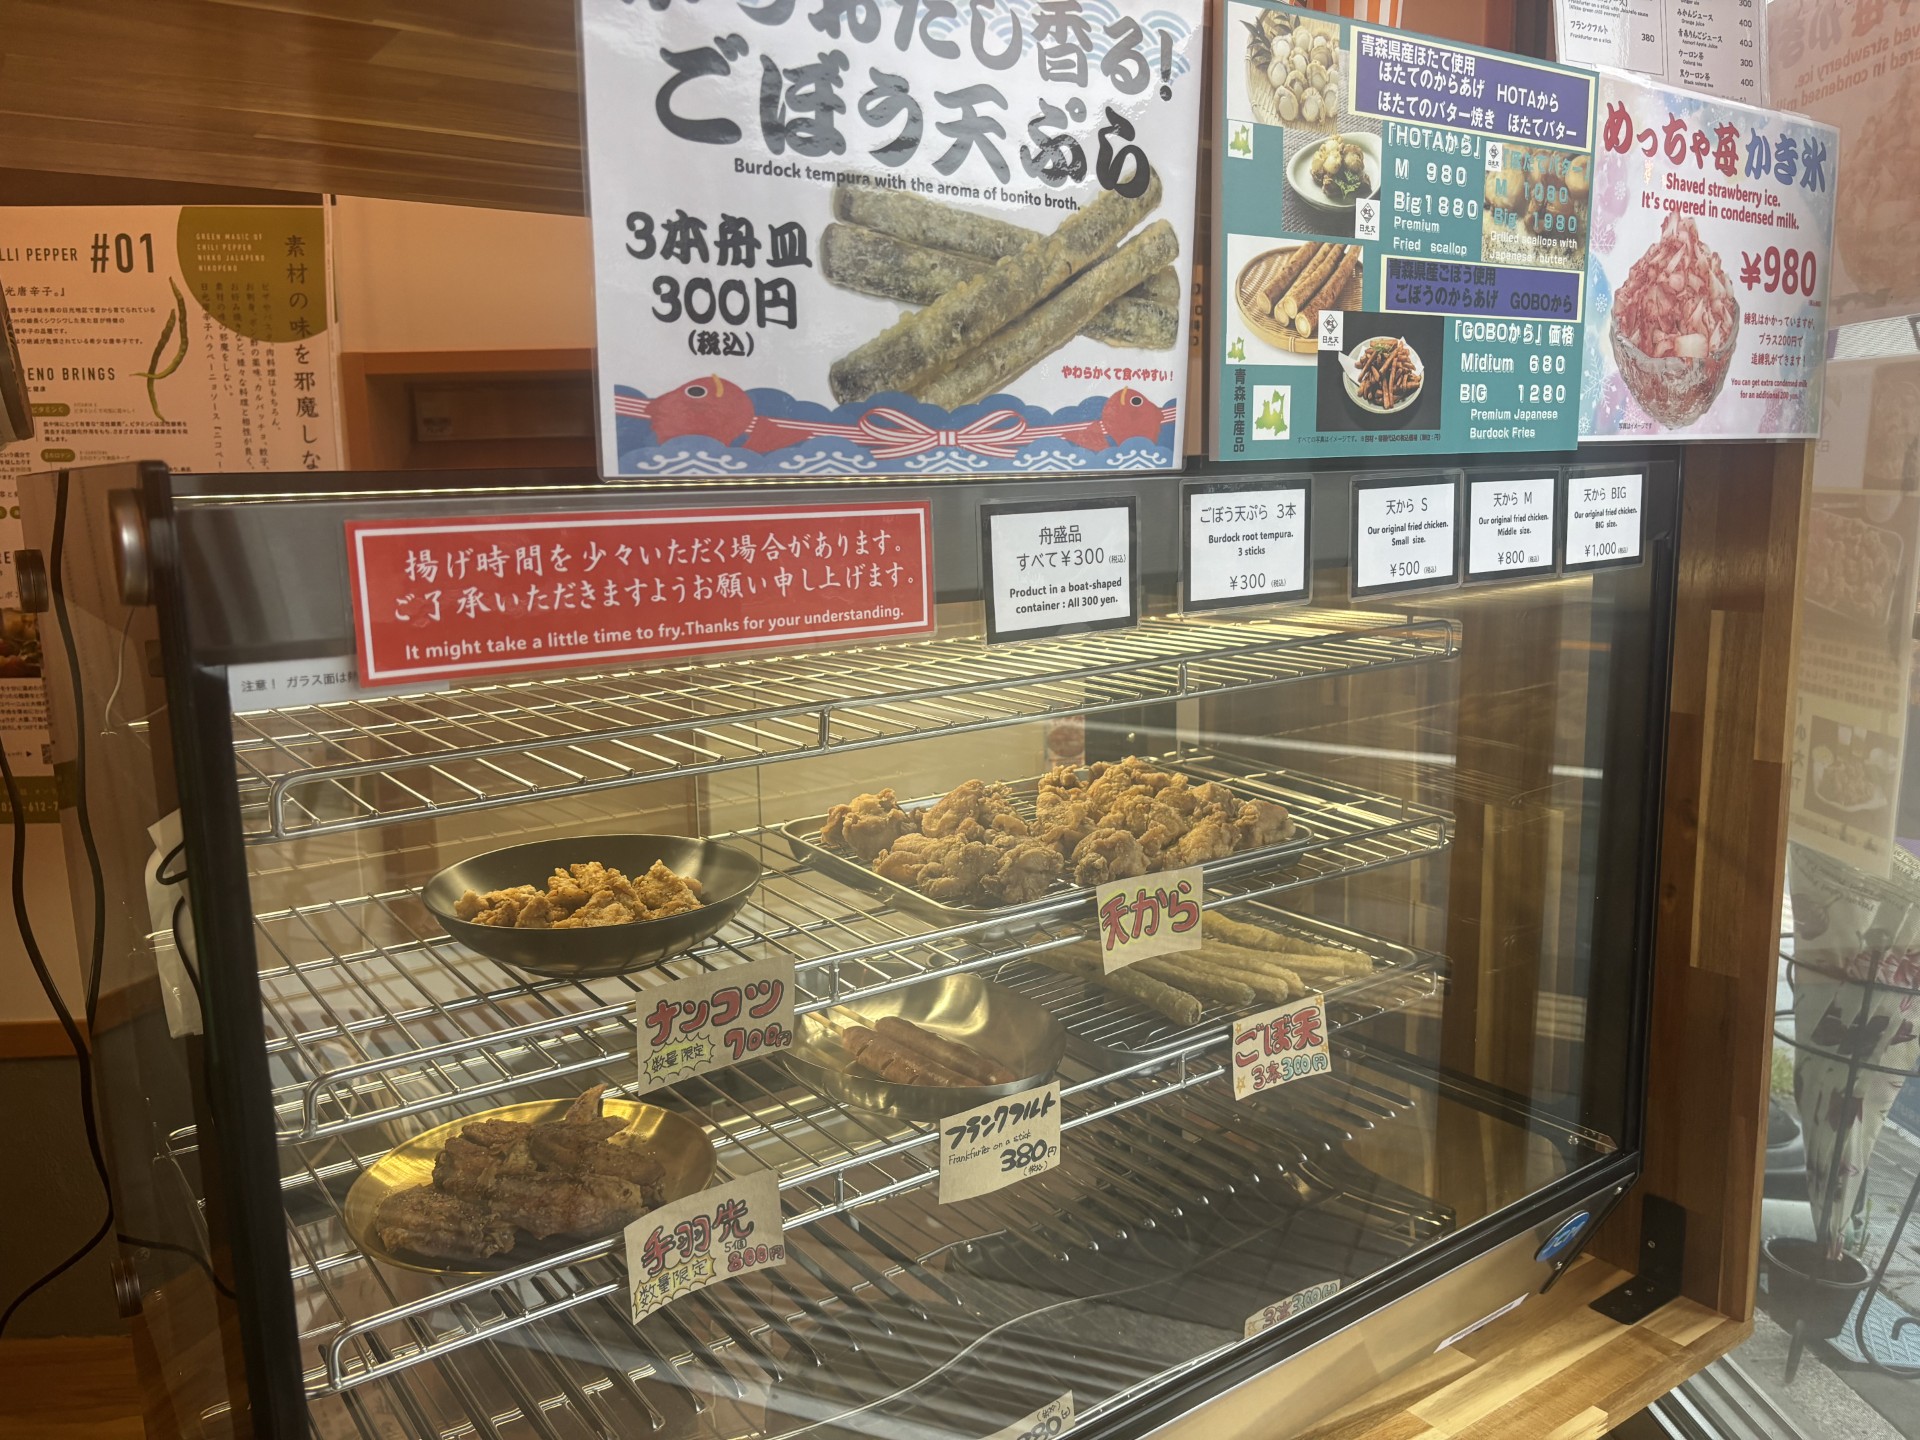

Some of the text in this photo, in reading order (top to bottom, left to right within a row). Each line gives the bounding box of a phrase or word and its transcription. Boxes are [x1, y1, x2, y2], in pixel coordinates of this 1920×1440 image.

[1739, 0, 1752, 8] 300
[1677, 8, 1752, 28] みかんジュース 400
[1570, 20, 1655, 42] フランクフルト 380
[1739, 39, 1753, 48] 400
[1361, 34, 1475, 77] 青森県産ほたて使用
[1678, 49, 1753, 68] ウーロン茶 300
[1379, 60, 1559, 113] ほたてのからあげ HOTAから
[1680, 69, 1754, 87] 黒ウーロン茶 400
[655, 33, 1151, 199] ごぼう天ぷら
[1378, 90, 1577, 140] ほたてのバター焼き ほたてバター
[1395, 158, 1467, 187] M 980
[734, 158, 1081, 211] Burdock tempura with the aroma of bonito broth.
[1495, 178, 1568, 204] M 1080
[1666, 172, 1781, 209] Shaved strawberry ice.
[1494, 208, 1578, 233] Big 1980
[1642, 191, 1800, 230] It's covered in condensed milk.
[1394, 216, 1440, 233] Premium
[196, 233, 249, 241] GREEN MAGIC
[626, 209, 813, 268] 3本舟皿
[1393, 236, 1467, 256] Fried scallop
[1490, 230, 1578, 249] Grilled scallops with
[26, 233, 154, 273] PEPPER #01
[1489, 249, 1568, 265] Japanese butter
[1389, 259, 1496, 286] 青森県産ごぼう使用
[1740, 246, 1816, 297] ¥980
[652, 275, 797, 329] 300円
[1395, 284, 1572, 314] ごぼうのからあげ GOBOから
[688, 330, 754, 357] (税込)
[1548, 324, 1575, 347] 価格
[1759, 333, 1803, 347] プラス200円で
[285, 234, 321, 470] 素材の味を邪魔しな
[1061, 365, 1174, 382] やわらかくて食べやすい!
[1461, 352, 1566, 374] Midium 680
[63, 367, 116, 381] BRINGS
[1731, 378, 1773, 388] You can get extra
[1460, 383, 1566, 403] BIG 1280
[1233, 368, 1246, 452] 青森県産品
[1470, 408, 1558, 421] Premium Japanese
[1470, 427, 1535, 439] Burdock Fries
[1493, 491, 1532, 507] 天から M
[1583, 486, 1627, 502] 天から BIG
[1200, 502, 1296, 523] ごぼう天ぷら 3本
[1386, 497, 1428, 516] 天から S
[1367, 520, 1449, 535] Our original fried chicken.
[1478, 512, 1549, 526] Our original fried chicken.
[1595, 519, 1618, 529] BIG size.
[1039, 524, 1081, 545] 舟盛品
[1208, 530, 1294, 544] Burdock root tempura.
[1391, 535, 1426, 546] Small size.
[1497, 526, 1531, 536] Middle size.
[404, 529, 901, 583] 揚げ時間を少々いただく場合があります。
[1016, 547, 1105, 571] すべて¥300
[1238, 546, 1266, 556] 3 sticks
[1497, 550, 1525, 565] ¥800
[1585, 542, 1617, 557] ¥1,000
[1390, 560, 1420, 577] ¥500
[395, 562, 914, 621] ご了承いただきますようお願い申し上げます。
[1010, 586, 1047, 598] Product
[1049, 584, 1058, 594] in
[1068, 577, 1122, 592] boat-shaped
[1229, 573, 1266, 591] ¥300
[1016, 596, 1118, 614] container All 300 yen.
[406, 645, 420, 660] It
[426, 639, 481, 660] might
[487, 636, 527, 653] take
[532, 638, 543, 648] a
[548, 630, 589, 647] little
[593, 624, 632, 643] time
[636, 626, 654, 640] to
[743, 615, 764, 630] for
[768, 614, 801, 632] your
[804, 606, 904, 625] understanding.
[1100, 880, 1200, 951] 天から
[645, 979, 784, 1047] ナンコツ
[724, 1022, 792, 1060] 700円
[1235, 1005, 1323, 1068] ごぼ天
[651, 1043, 706, 1074] 数量限定
[945, 1091, 1056, 1150] フランクフルト
[993, 1142, 1003, 1150] on
[1000, 1139, 1057, 1172] 380円
[641, 1199, 754, 1276] 手羽先
[728, 1243, 785, 1273] 800円
[639, 1258, 709, 1309] 数量限定
